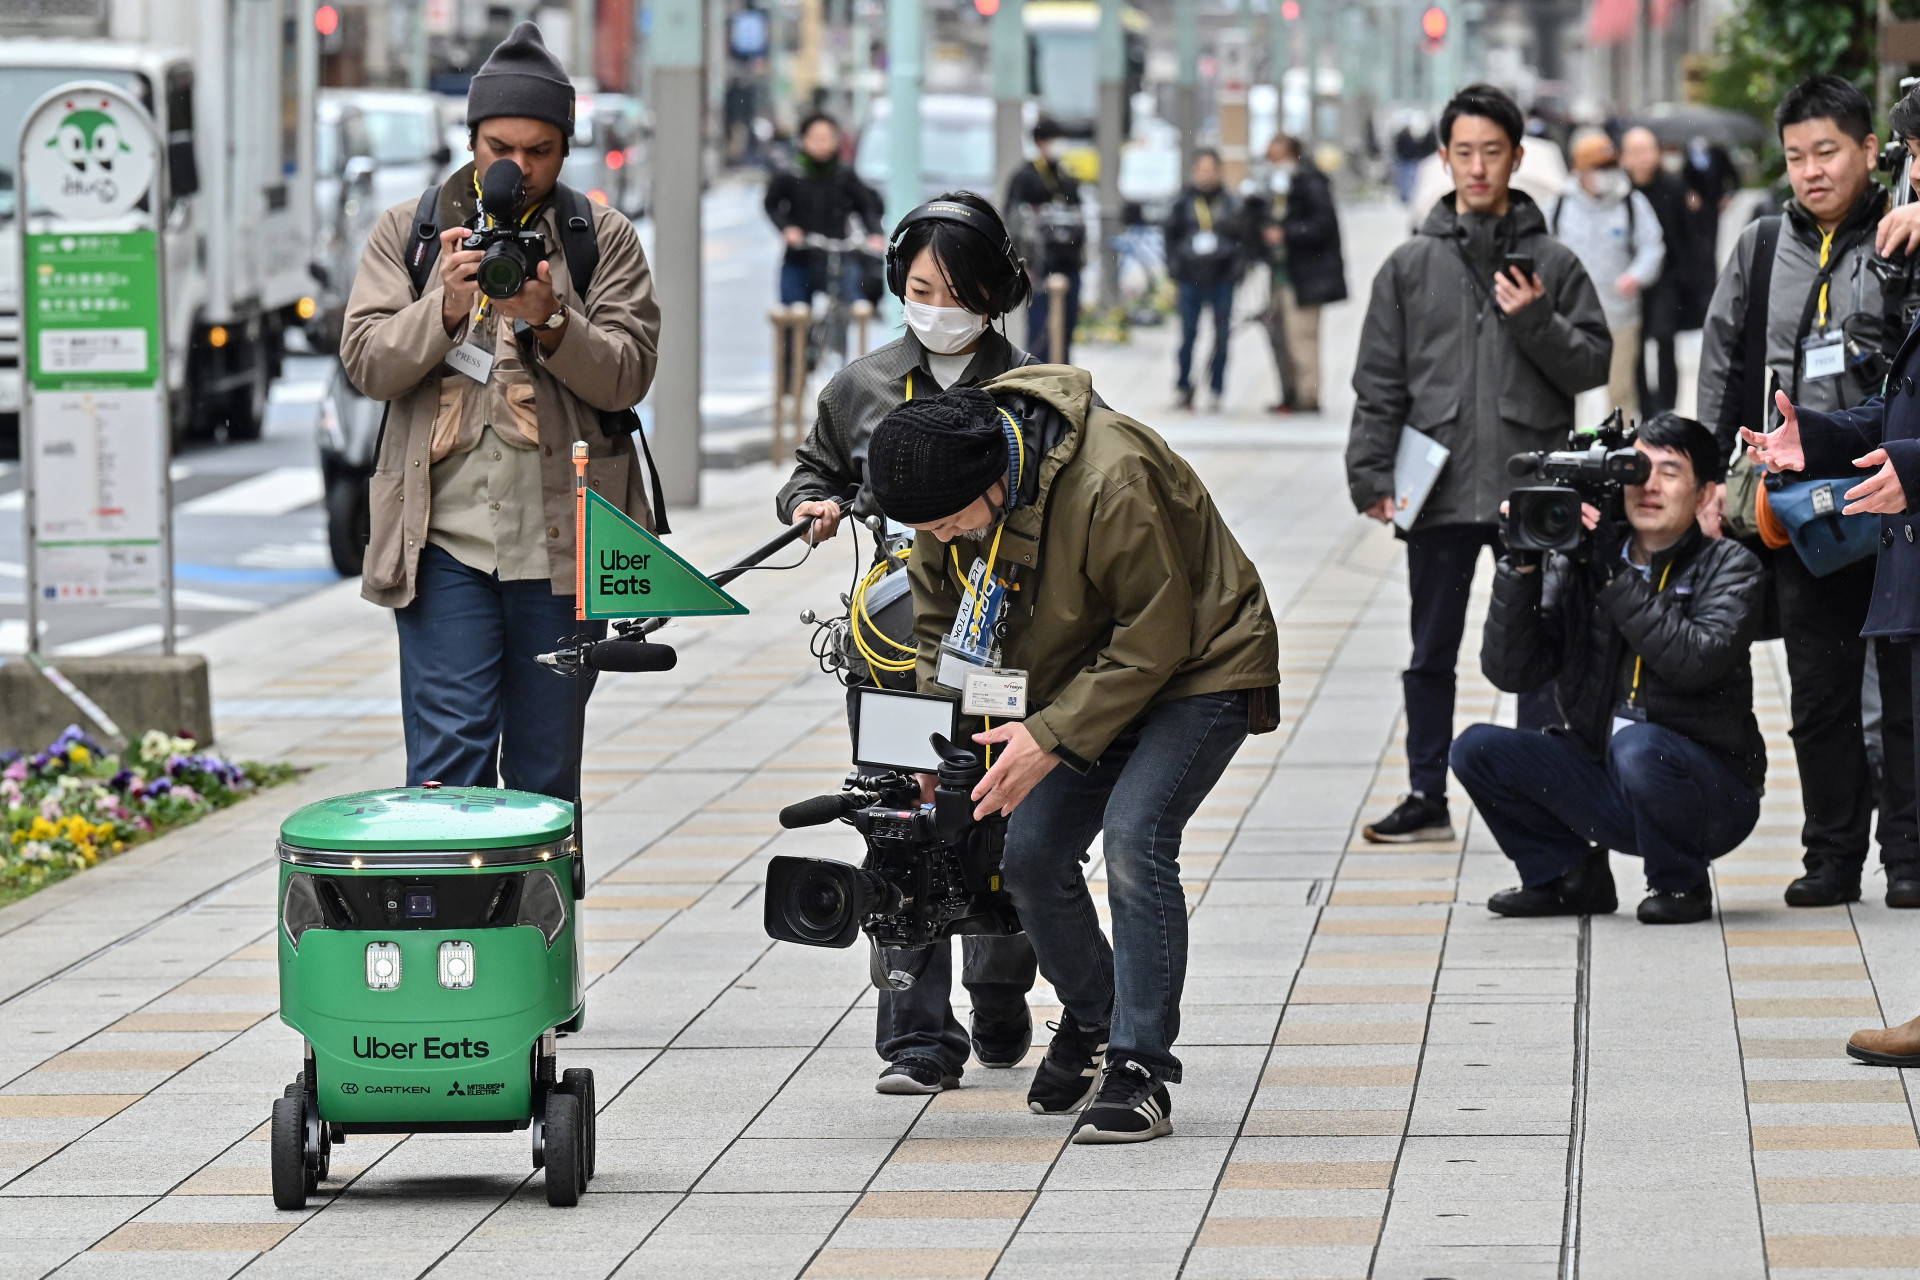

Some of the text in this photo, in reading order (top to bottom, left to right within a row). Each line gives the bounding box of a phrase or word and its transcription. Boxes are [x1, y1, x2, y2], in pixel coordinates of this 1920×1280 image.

[455, 349, 482, 368] PRESS
[600, 549, 651, 571] Uber
[600, 574, 651, 596] Eats
[353, 1036, 490, 1059] Uber Eats
[364, 1085, 431, 1094] CARTKEN
[467, 1082, 505, 1090] MITSUBISHI
